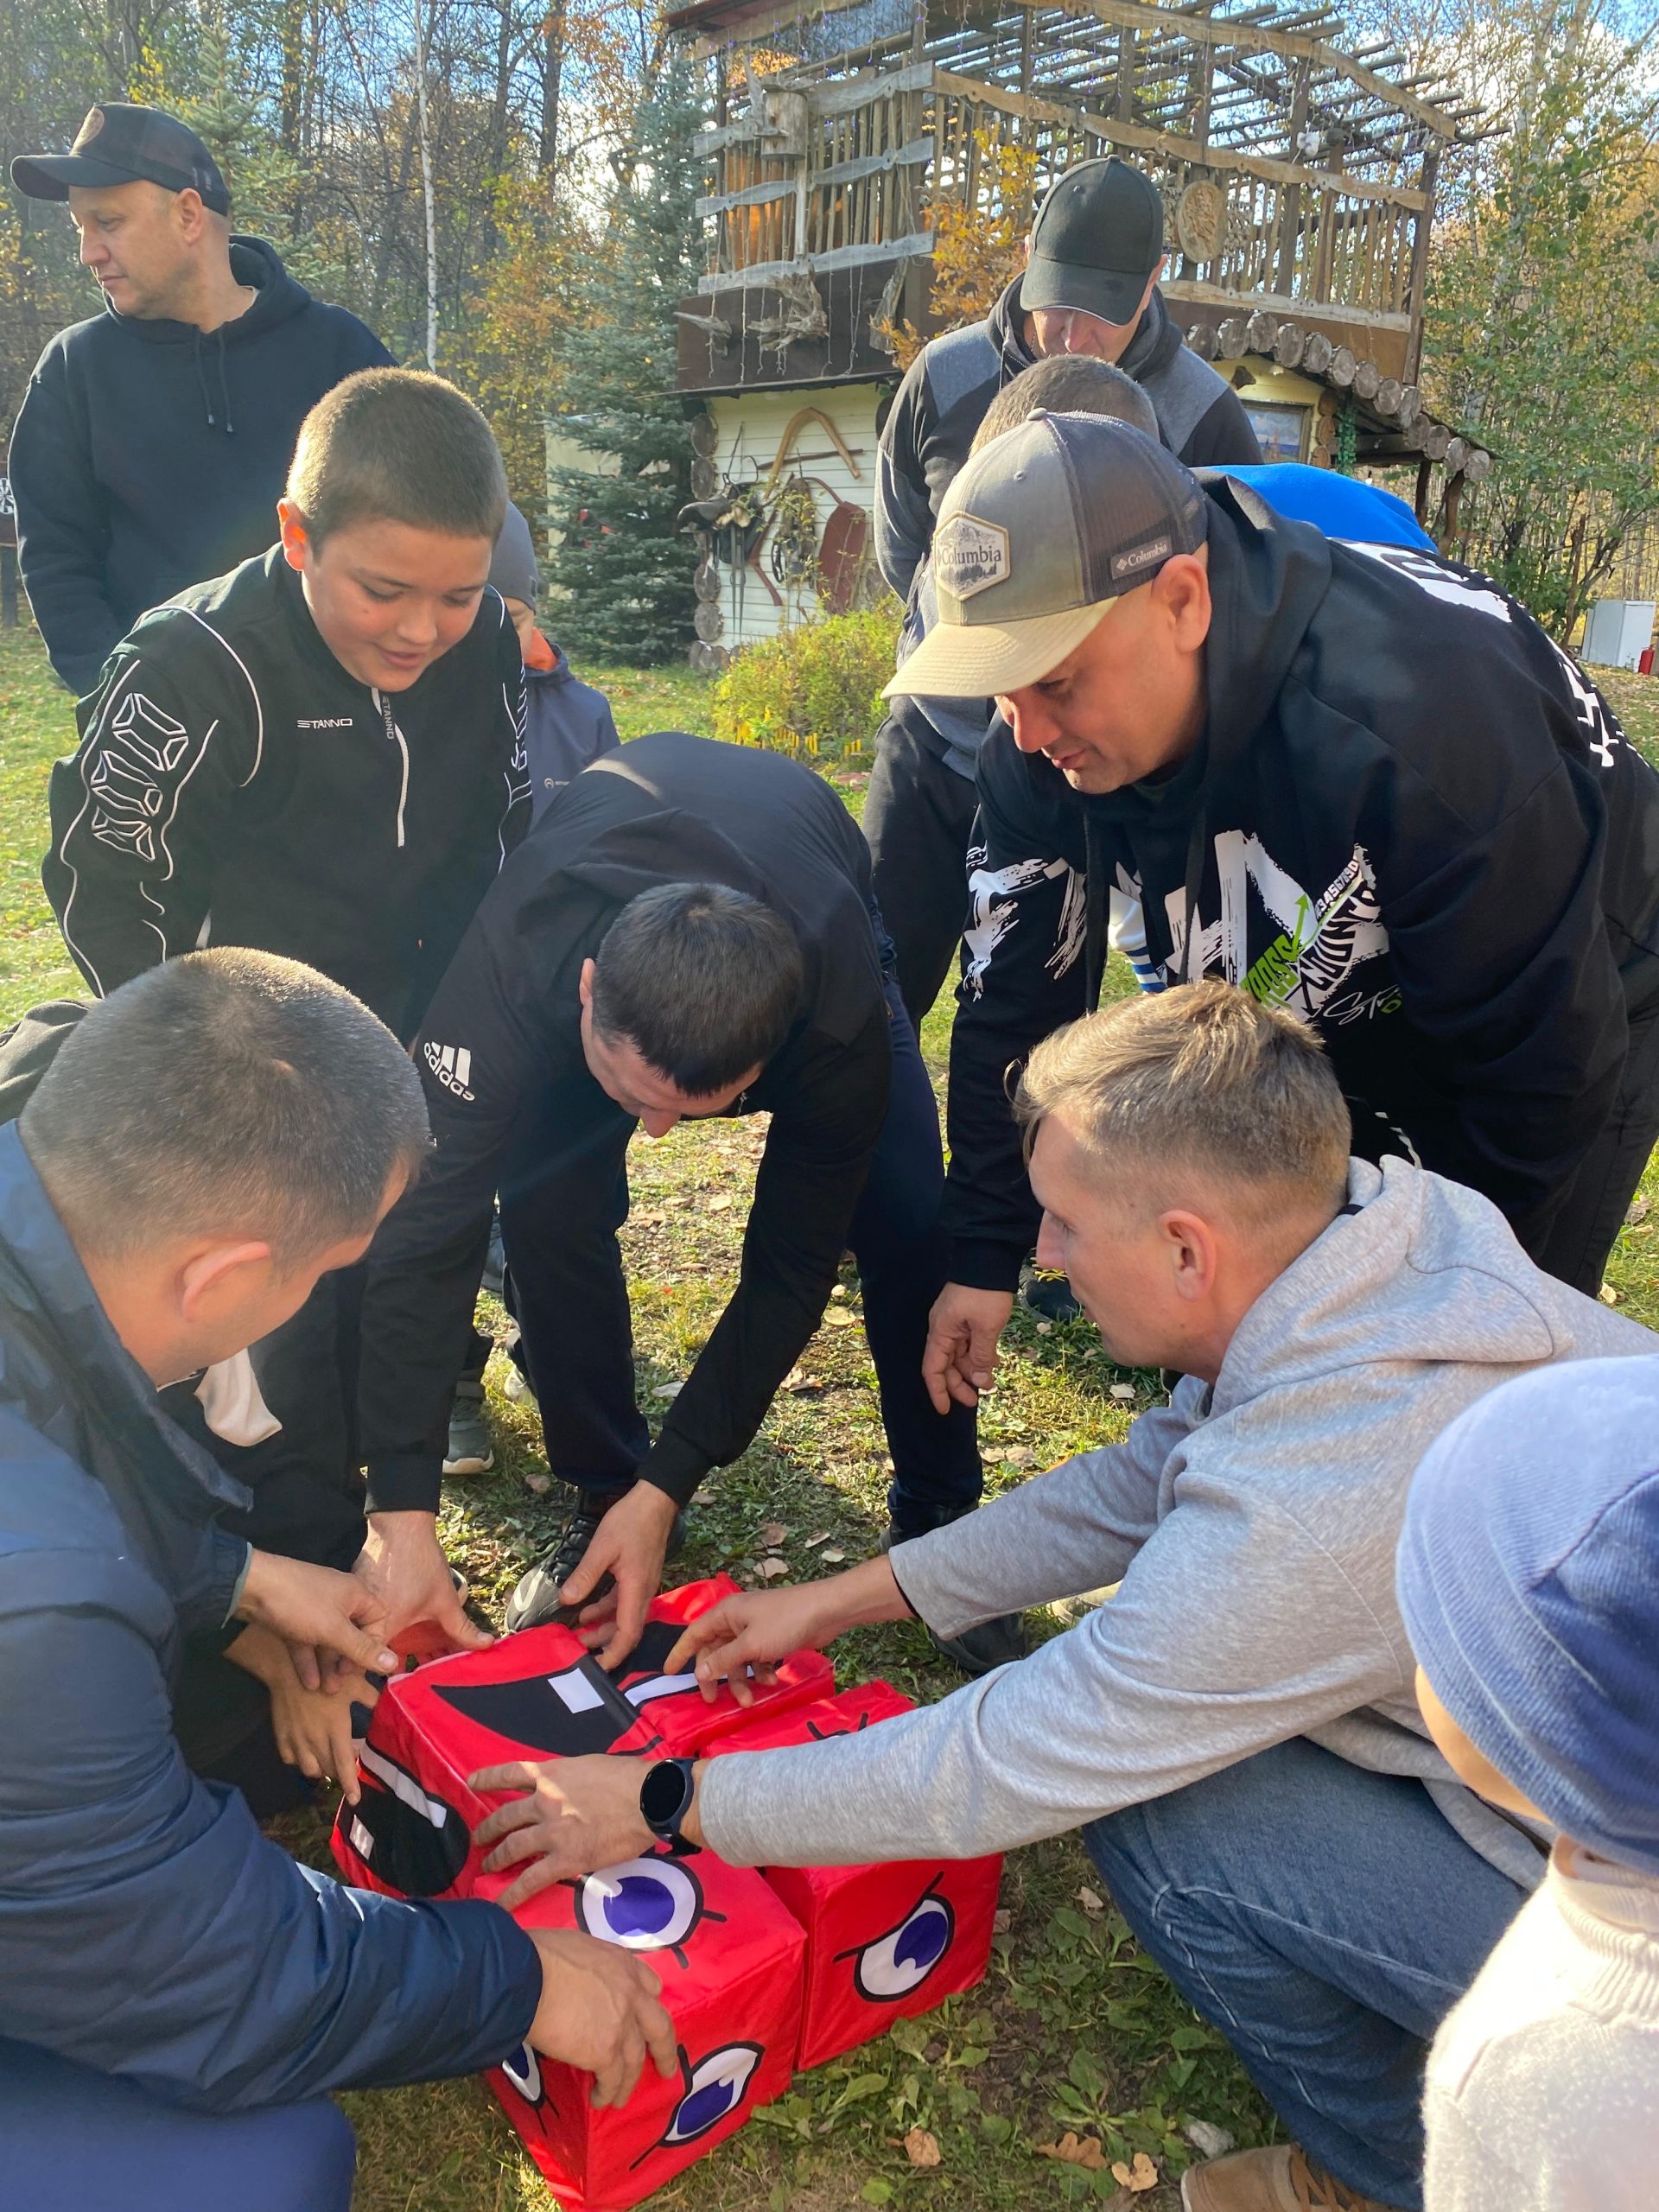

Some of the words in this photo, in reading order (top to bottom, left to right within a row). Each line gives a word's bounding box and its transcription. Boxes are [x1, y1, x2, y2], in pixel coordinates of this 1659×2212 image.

[941, 545, 1001, 567] Columbia
[1128, 543, 1167, 567] Columbia
[296, 718, 353, 729] STANNO
[423, 1042, 475, 1101] adidas
